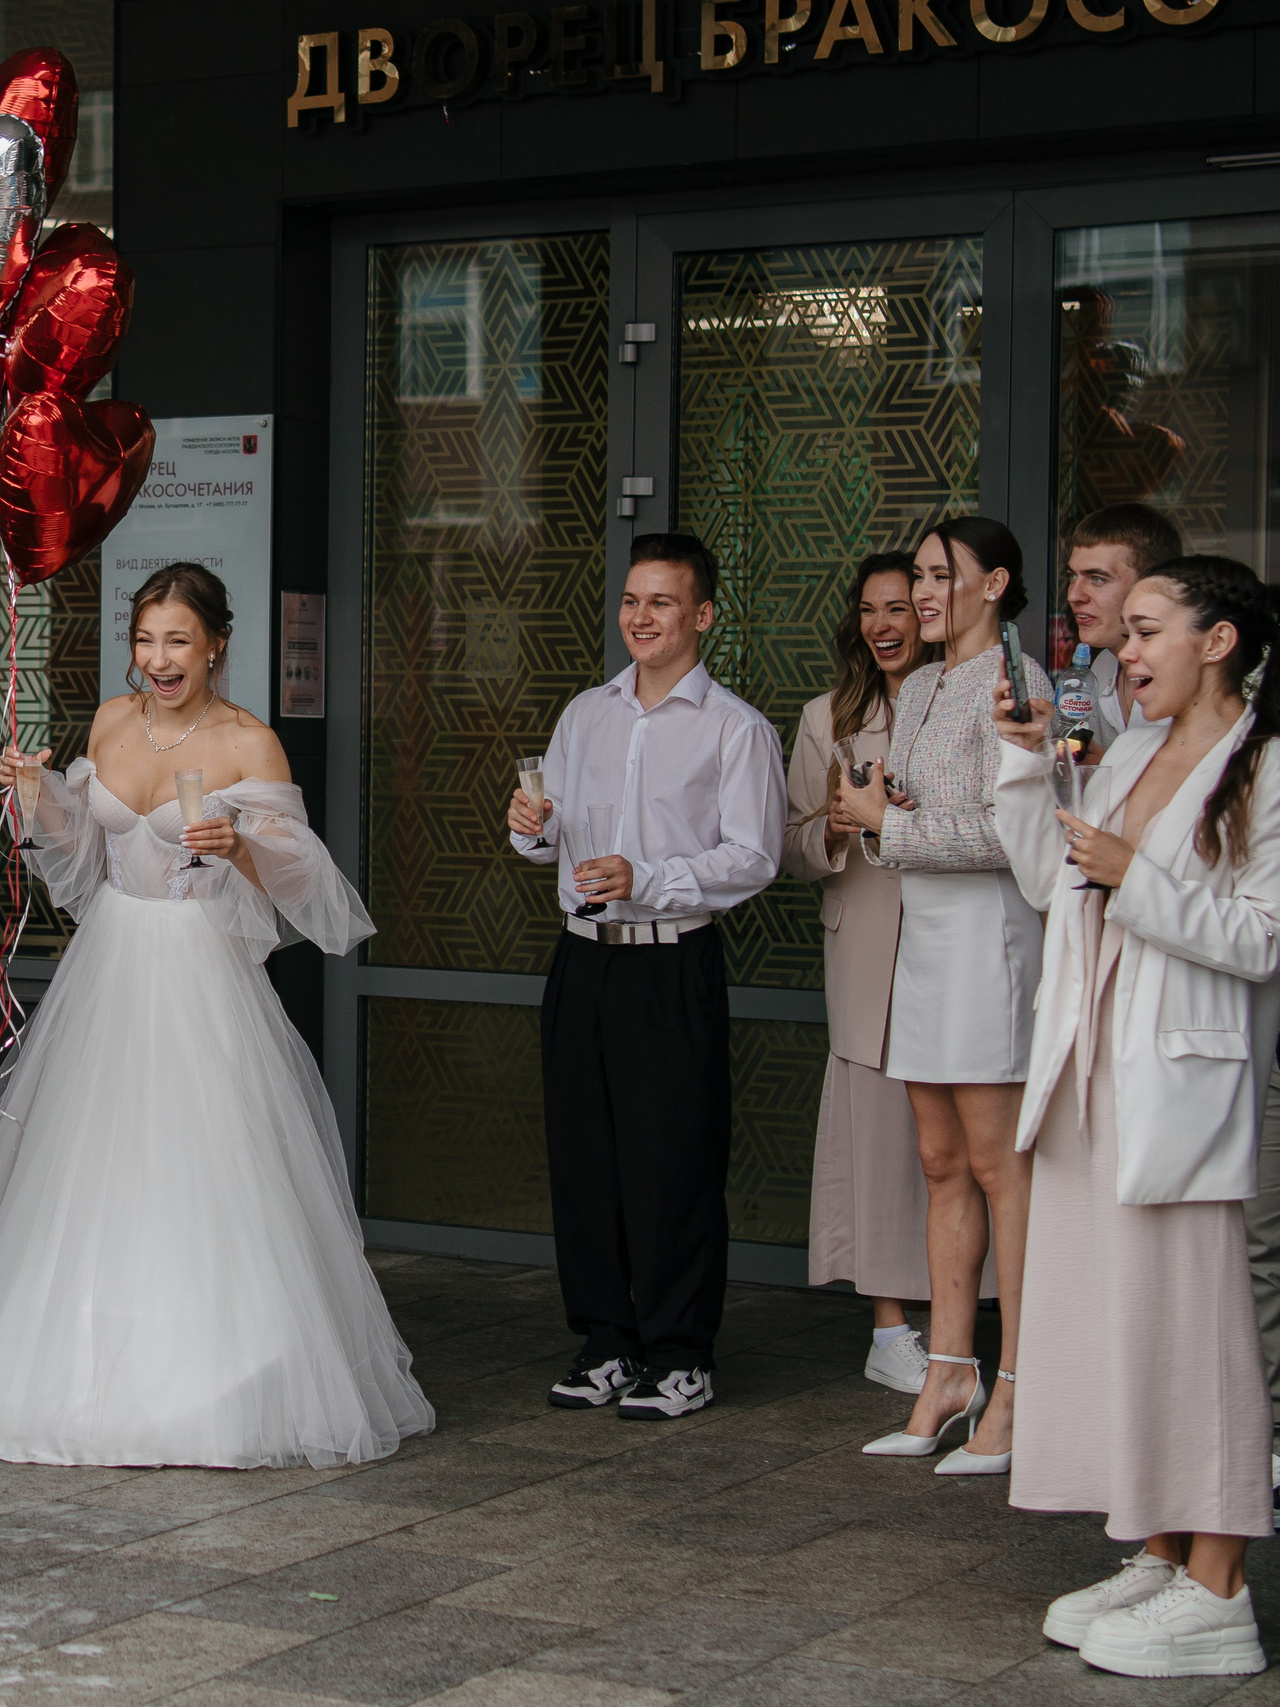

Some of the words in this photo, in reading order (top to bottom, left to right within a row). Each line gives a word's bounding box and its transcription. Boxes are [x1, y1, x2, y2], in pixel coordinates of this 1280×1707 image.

[287, 0, 664, 128] ДВОРЕЦ
[701, 0, 1221, 71] БРАКО
[150, 462, 176, 477] РЕЦ
[138, 481, 253, 498] КОСОЧЕТАНИЯ
[116, 559, 138, 571] ВИД
